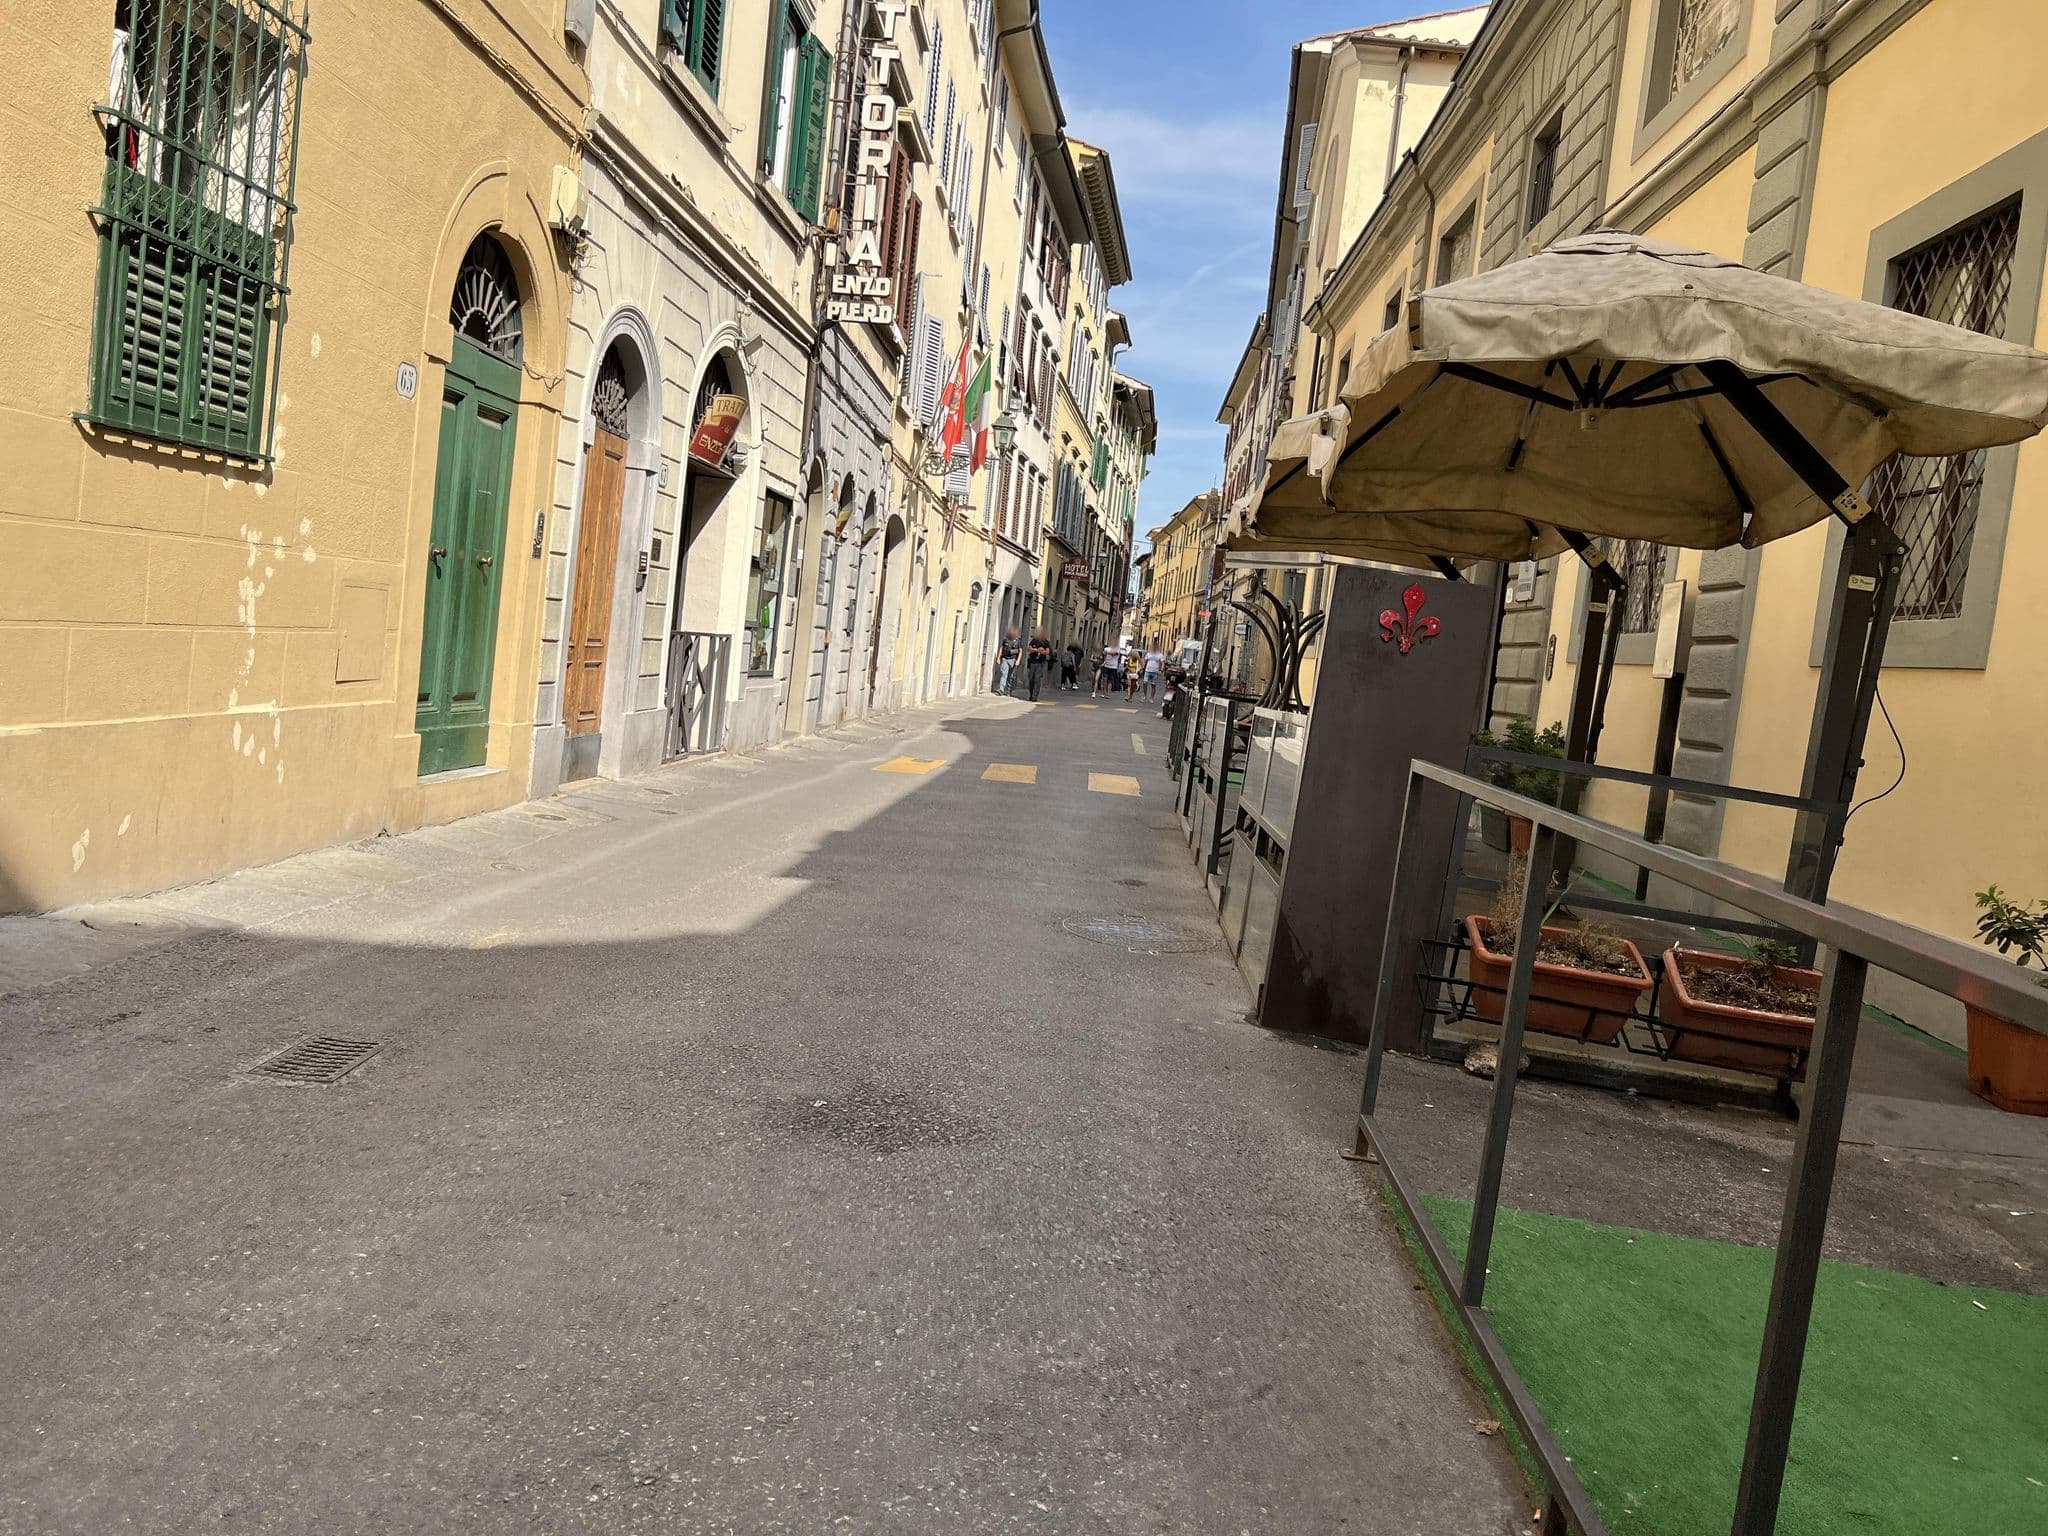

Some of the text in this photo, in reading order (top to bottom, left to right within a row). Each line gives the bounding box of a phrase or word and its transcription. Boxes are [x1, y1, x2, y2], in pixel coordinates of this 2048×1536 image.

[831, 274, 891, 297] ENZO
[826, 301, 893, 324] PIERO
[400, 369, 414, 393] 65
[1064, 563, 1090, 574] HOTEL
